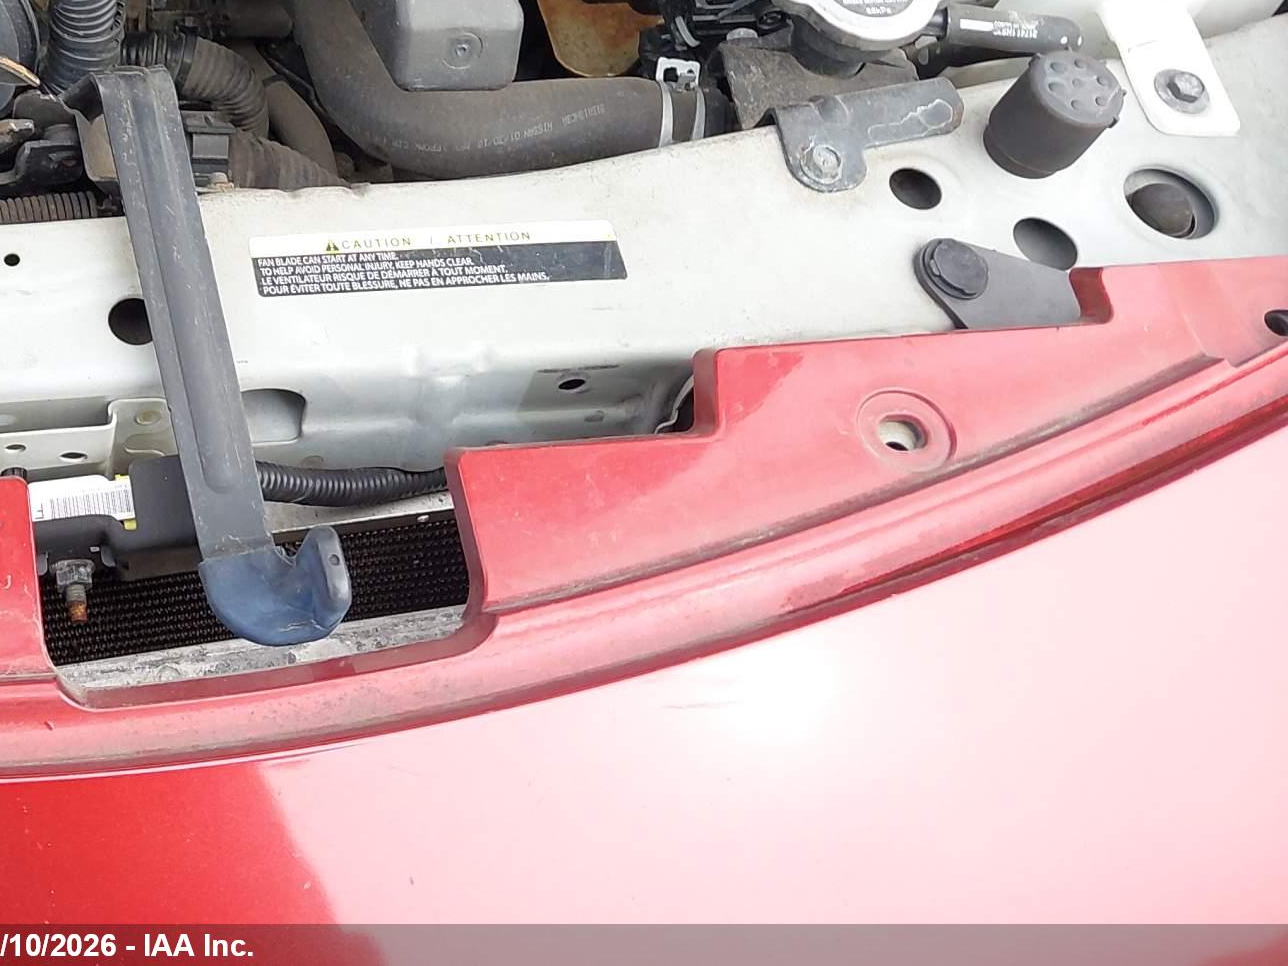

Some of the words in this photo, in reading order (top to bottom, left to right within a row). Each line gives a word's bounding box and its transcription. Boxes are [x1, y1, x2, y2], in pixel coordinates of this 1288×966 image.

[523, 122, 553, 139] NISSAN
[341, 237, 412, 250] CAUTION
[447, 231, 532, 245] ATTENTION
[258, 258, 275, 267] FAN
[276, 257, 302, 266] BLADE
[302, 256, 321, 265] CAN
[322, 254, 346, 264] START
[347, 253, 358, 263] AT
[359, 252, 376, 262] ANY
[377, 251, 399, 261] TIME.
[260, 267, 272, 276] TO
[274, 266, 294, 276] HELP
[295, 264, 321, 275] AVOID
[322, 262, 364, 274] PERSONAL
[365, 261, 395, 271] INJURY,
[396, 260, 415, 269] KEEP
[416, 258, 446, 268] HANDS
[447, 257, 474, 267] CLEAR.
[262, 276, 272, 286] LE
[273, 274, 332, 285] VENTILATEUR
[333, 272, 367, 282] RISQUE
[368, 271, 380, 280] DE
[381, 268, 430, 279] DÉMARRER
[431, 266, 439, 276] À
[439, 266, 464, 276] TOUT
[465, 264, 509, 275] MOMENT.
[263, 285, 289, 295] POUR
[290, 282, 321, 293] ÉVITER
[321, 281, 351, 292] TOUTE
[352, 279, 398, 291] BLESSURE,
[398, 278, 412, 288] NE
[413, 277, 430, 287] PAS
[431, 276, 444, 286] EN
[445, 273, 500, 285] APPROCHER
[500, 273, 517, 283] LES
[517, 271, 550, 282] MAINS.
